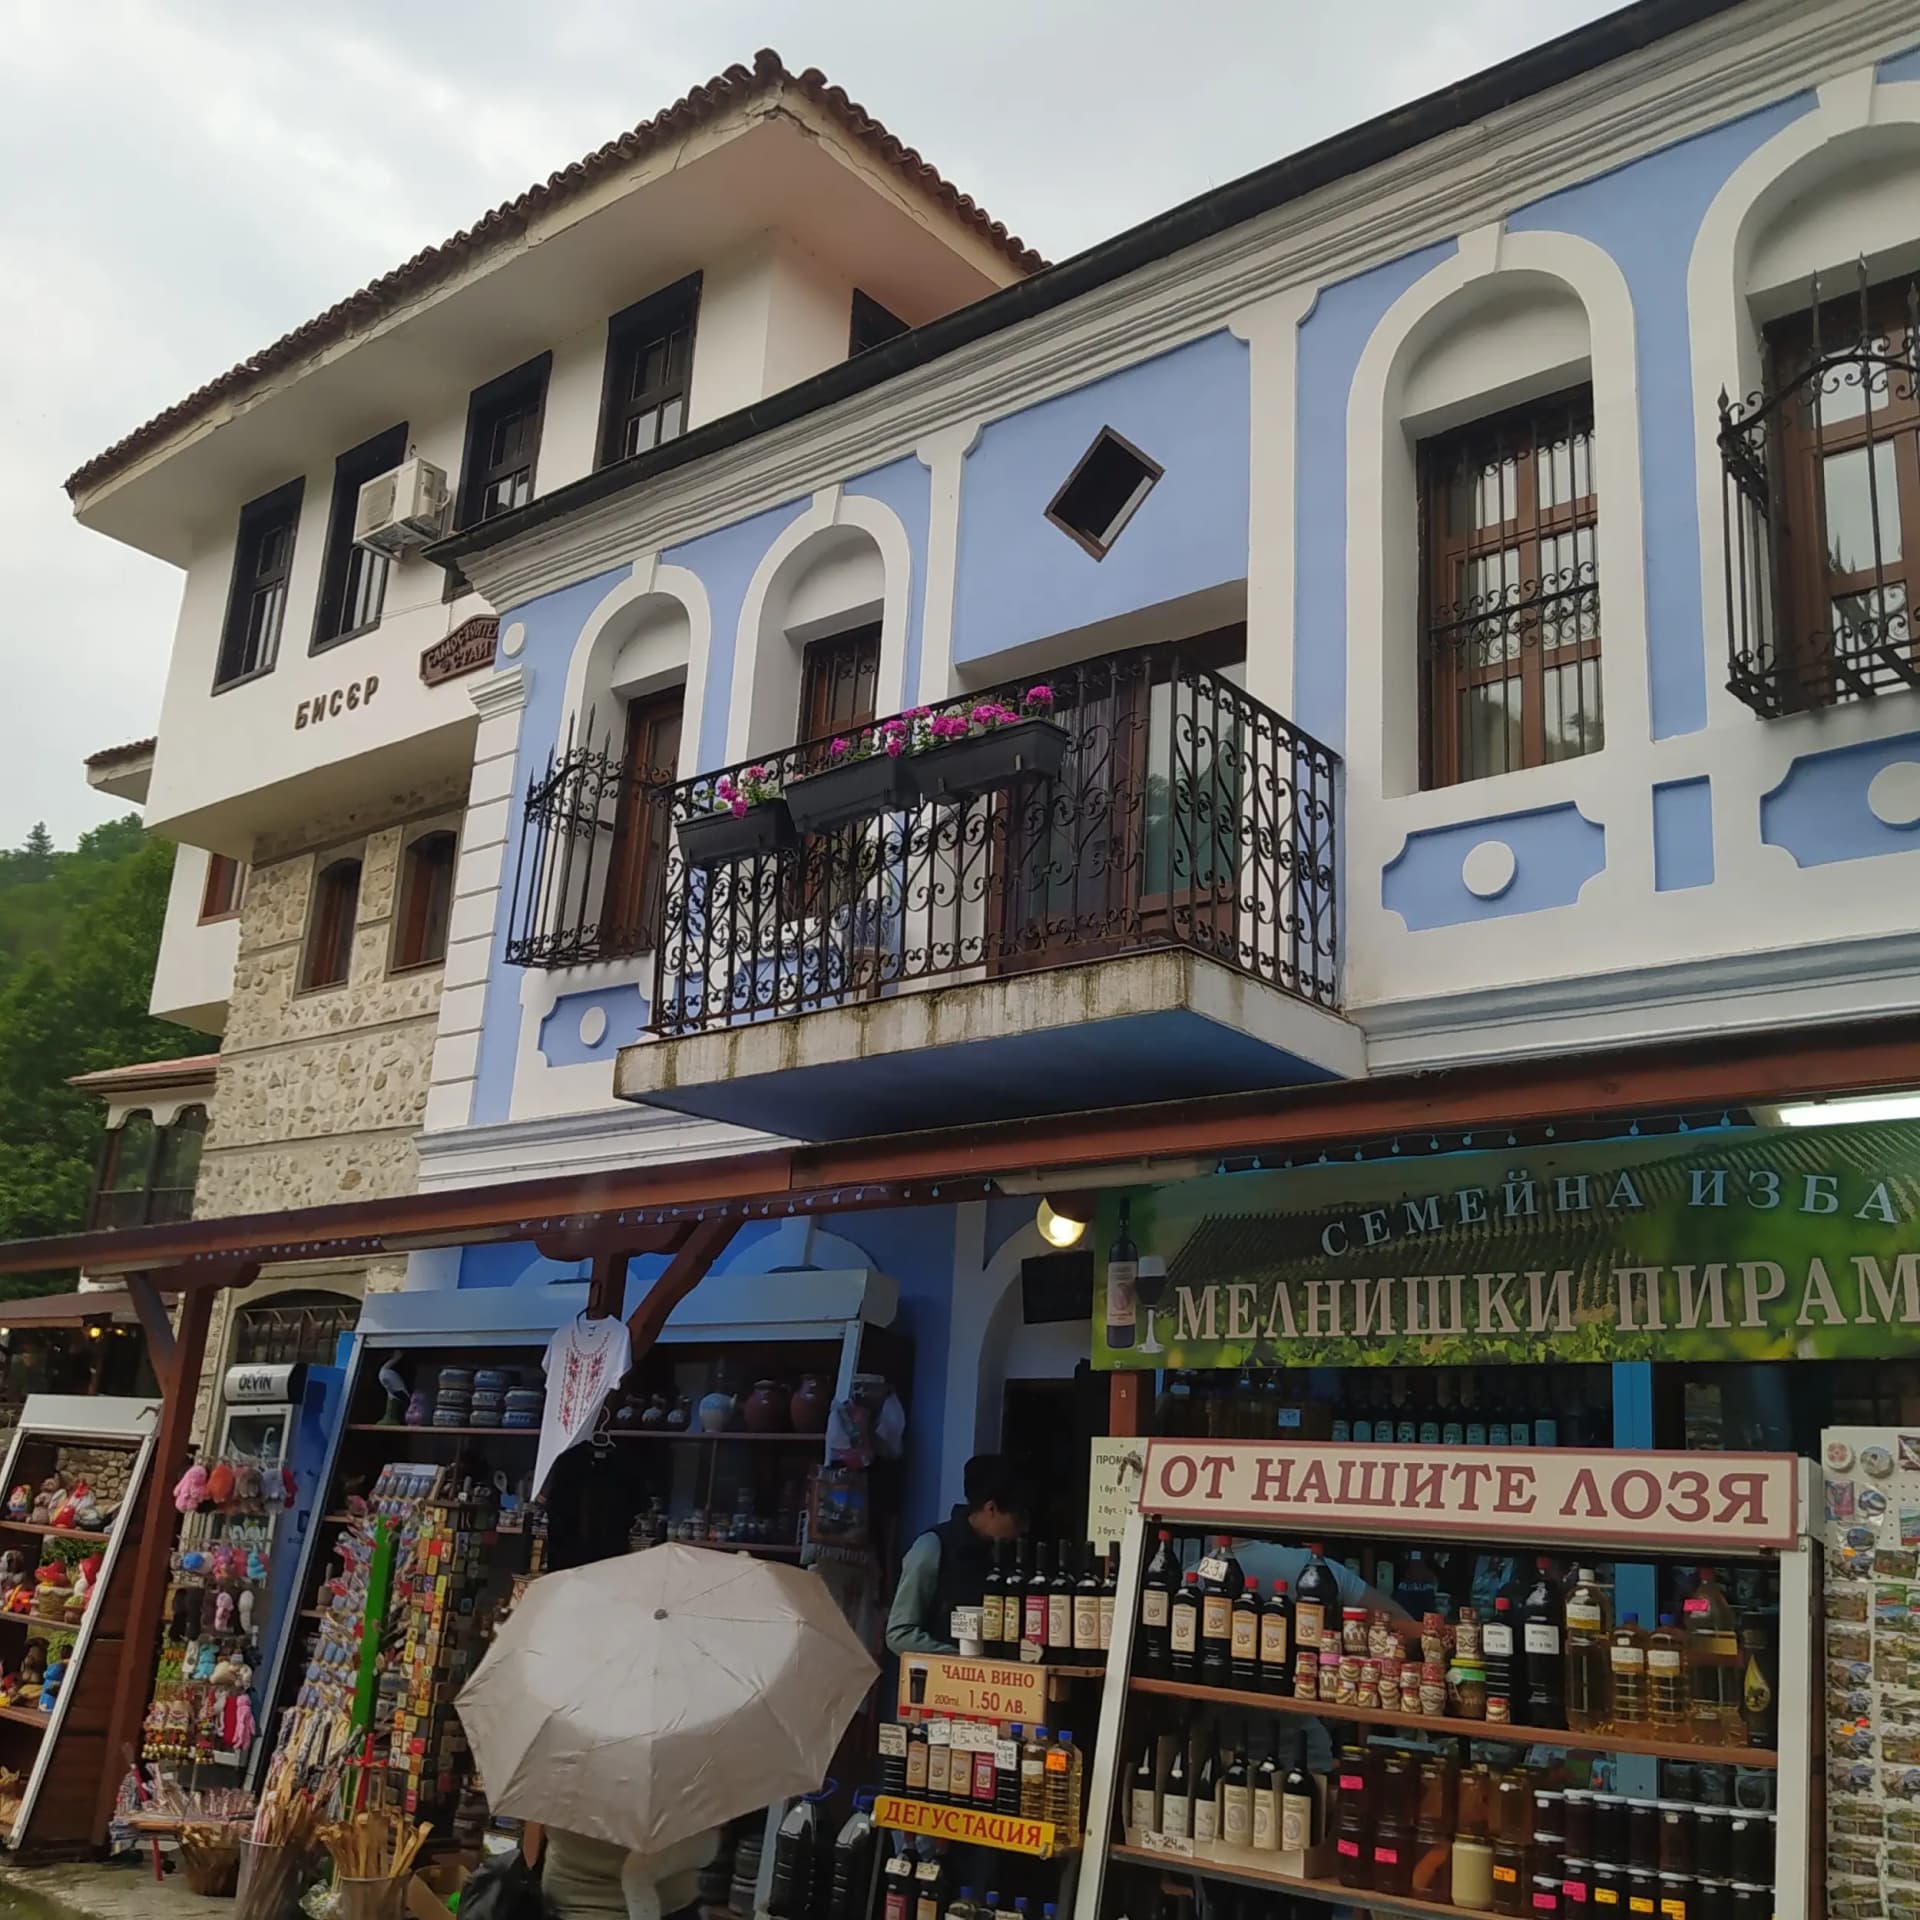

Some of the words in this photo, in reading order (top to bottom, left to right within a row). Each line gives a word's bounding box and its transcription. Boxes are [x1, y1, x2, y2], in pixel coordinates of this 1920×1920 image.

[1321, 1169, 1644, 1257] СЕМЕЙНА
[1687, 1169, 1899, 1223] ИЗБА
[1173, 1270, 1577, 1341] МЕЛНИШКИ
[1160, 1455, 1235, 1499] ОТ
[1251, 1458, 1537, 1514] НАШИТЕ
[1559, 1468, 1769, 1525] ЛОЗЯ
[942, 1664, 985, 1683] ЧАША
[990, 1669, 1035, 1689] ВИНО
[968, 1690, 1000, 1711] 1.50
[884, 1800, 1042, 1848] ДЕГУСТАЦИЯ
